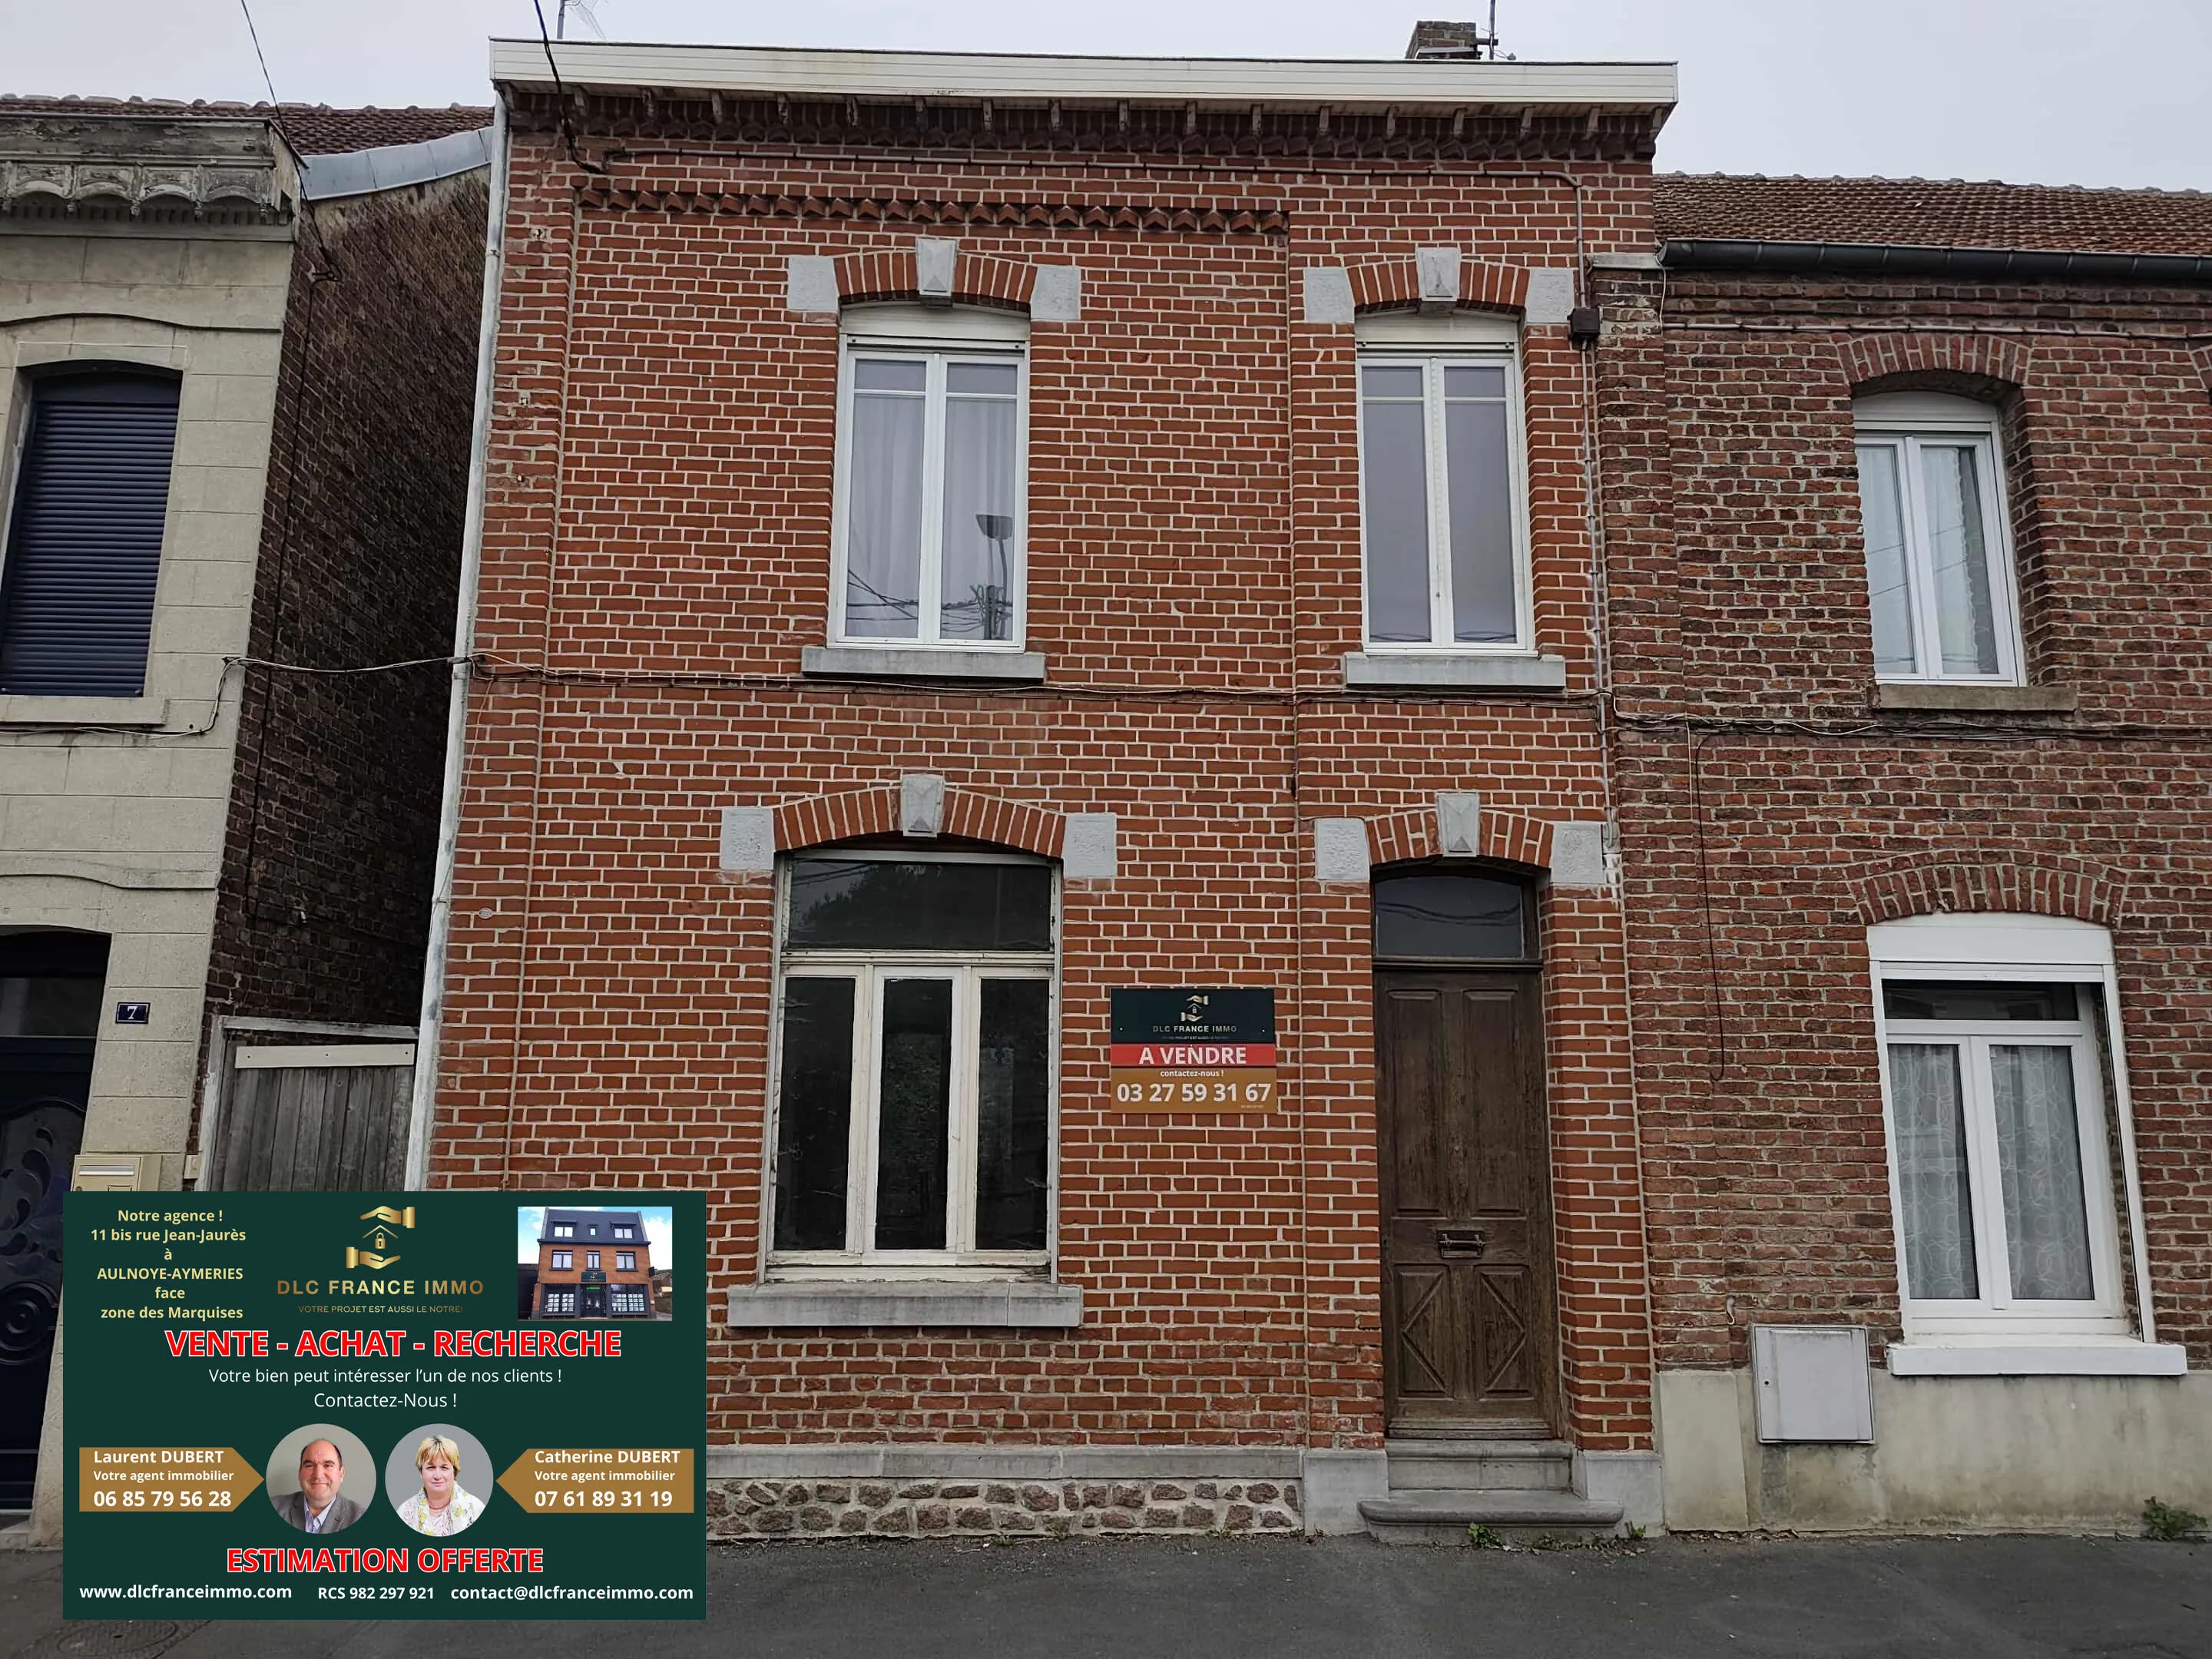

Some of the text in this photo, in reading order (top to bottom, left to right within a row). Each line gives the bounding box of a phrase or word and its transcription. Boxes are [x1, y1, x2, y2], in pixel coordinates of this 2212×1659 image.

[127, 1005, 139, 1020] 7
[1138, 1046, 1248, 1065] A VENDRE
[1160, 1070, 1220, 1078] contactez-nous
[1117, 1082, 1271, 1102] 03 27 59 31 67
